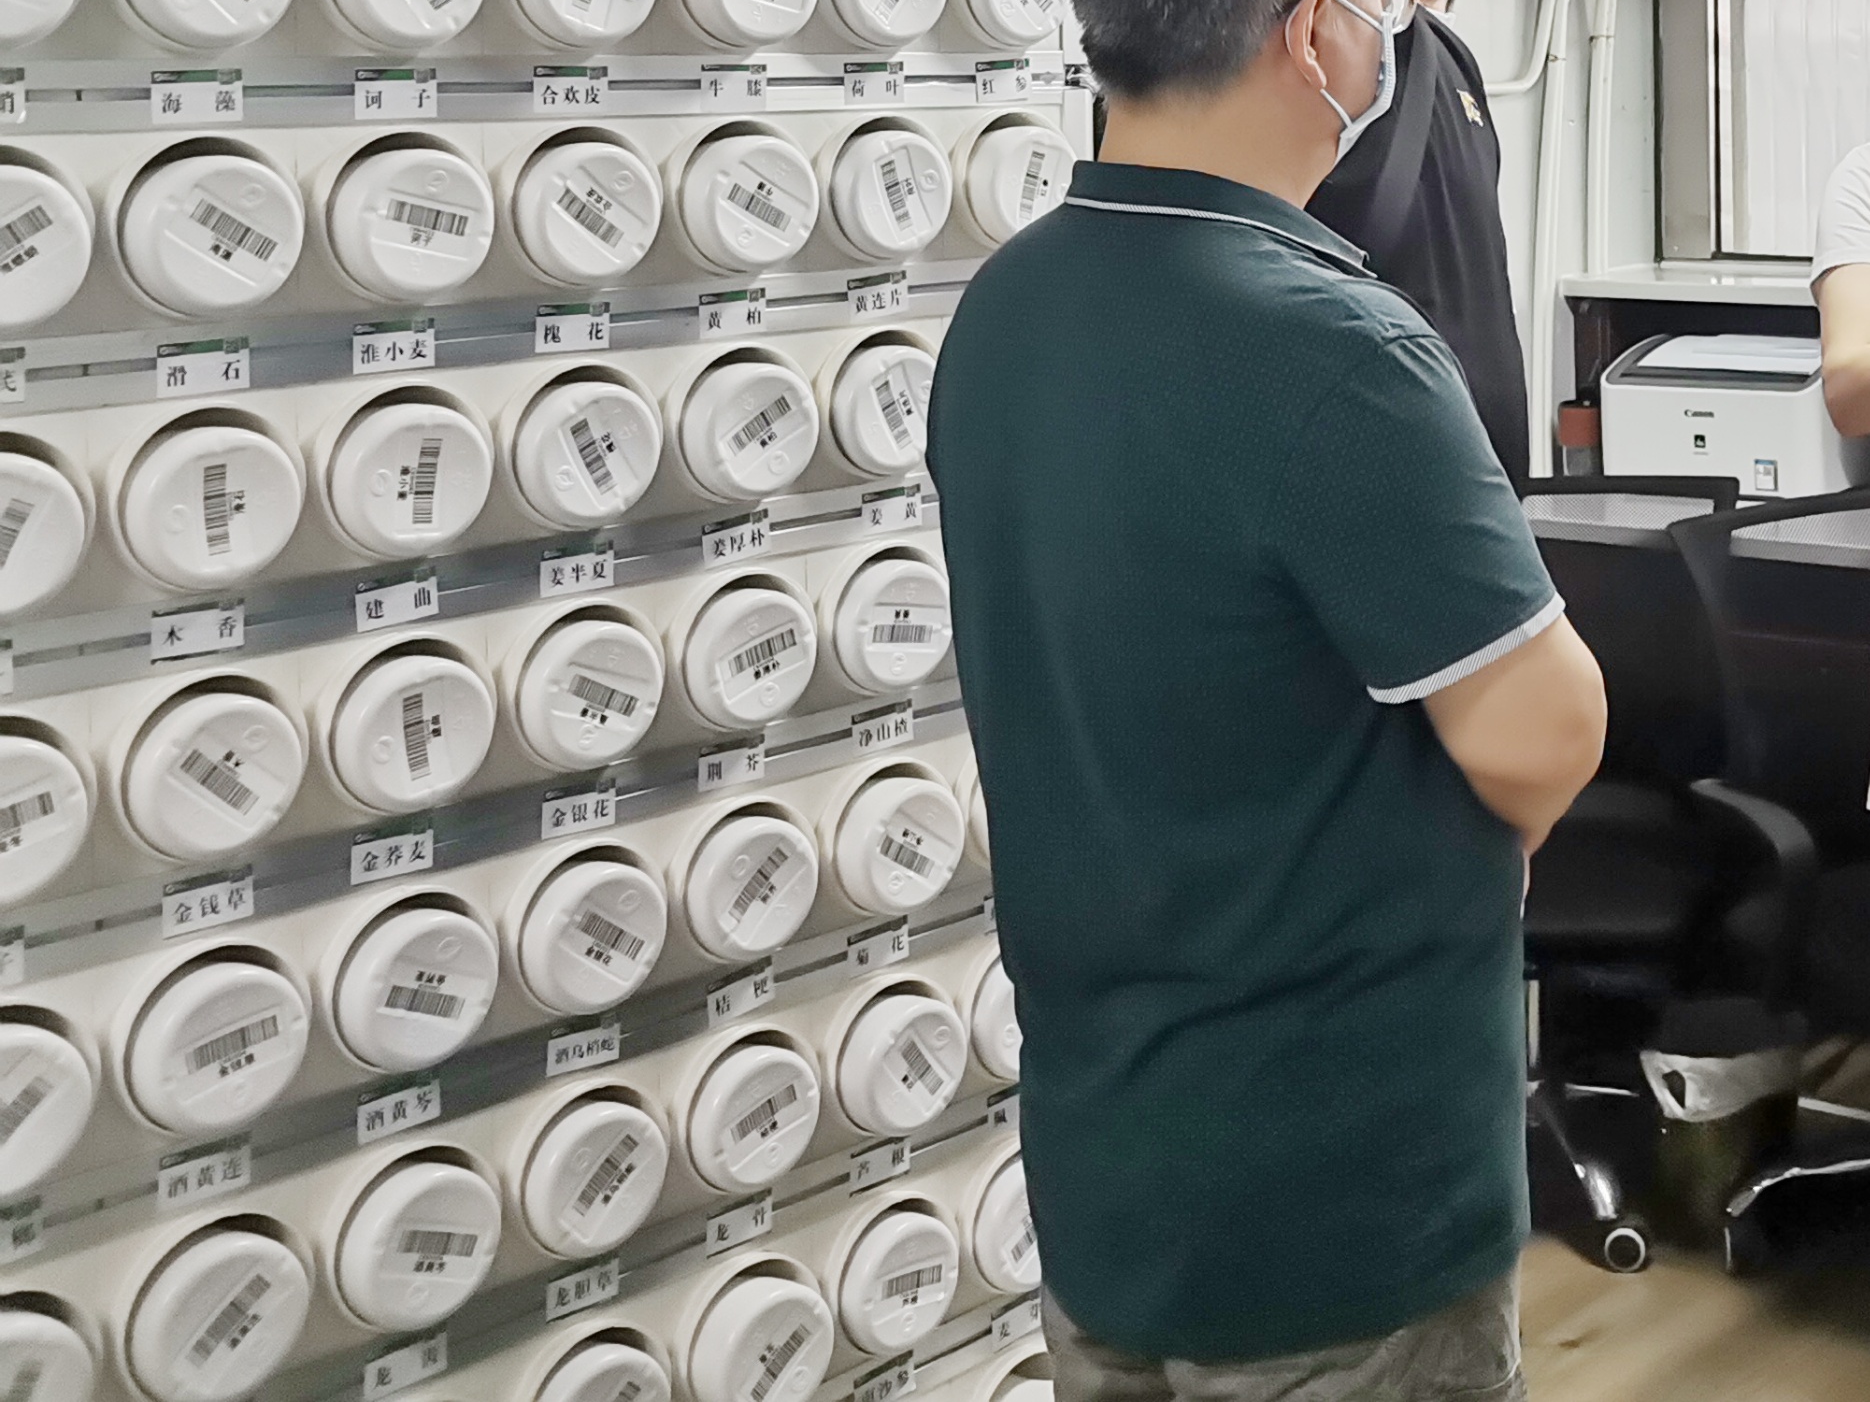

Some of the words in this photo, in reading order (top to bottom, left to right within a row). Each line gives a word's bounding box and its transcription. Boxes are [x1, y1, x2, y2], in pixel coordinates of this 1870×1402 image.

[541, 84, 602, 107] 合欢皮
[854, 288, 905, 313] 黄连片
[361, 337, 428, 366] 淮小麦
[712, 529, 765, 559] 姜厚朴
[550, 560, 608, 587] 姜半夏
[550, 798, 611, 829] 金银花
[361, 841, 427, 873] 金荞麦
[171, 888, 246, 924] 金钱草
